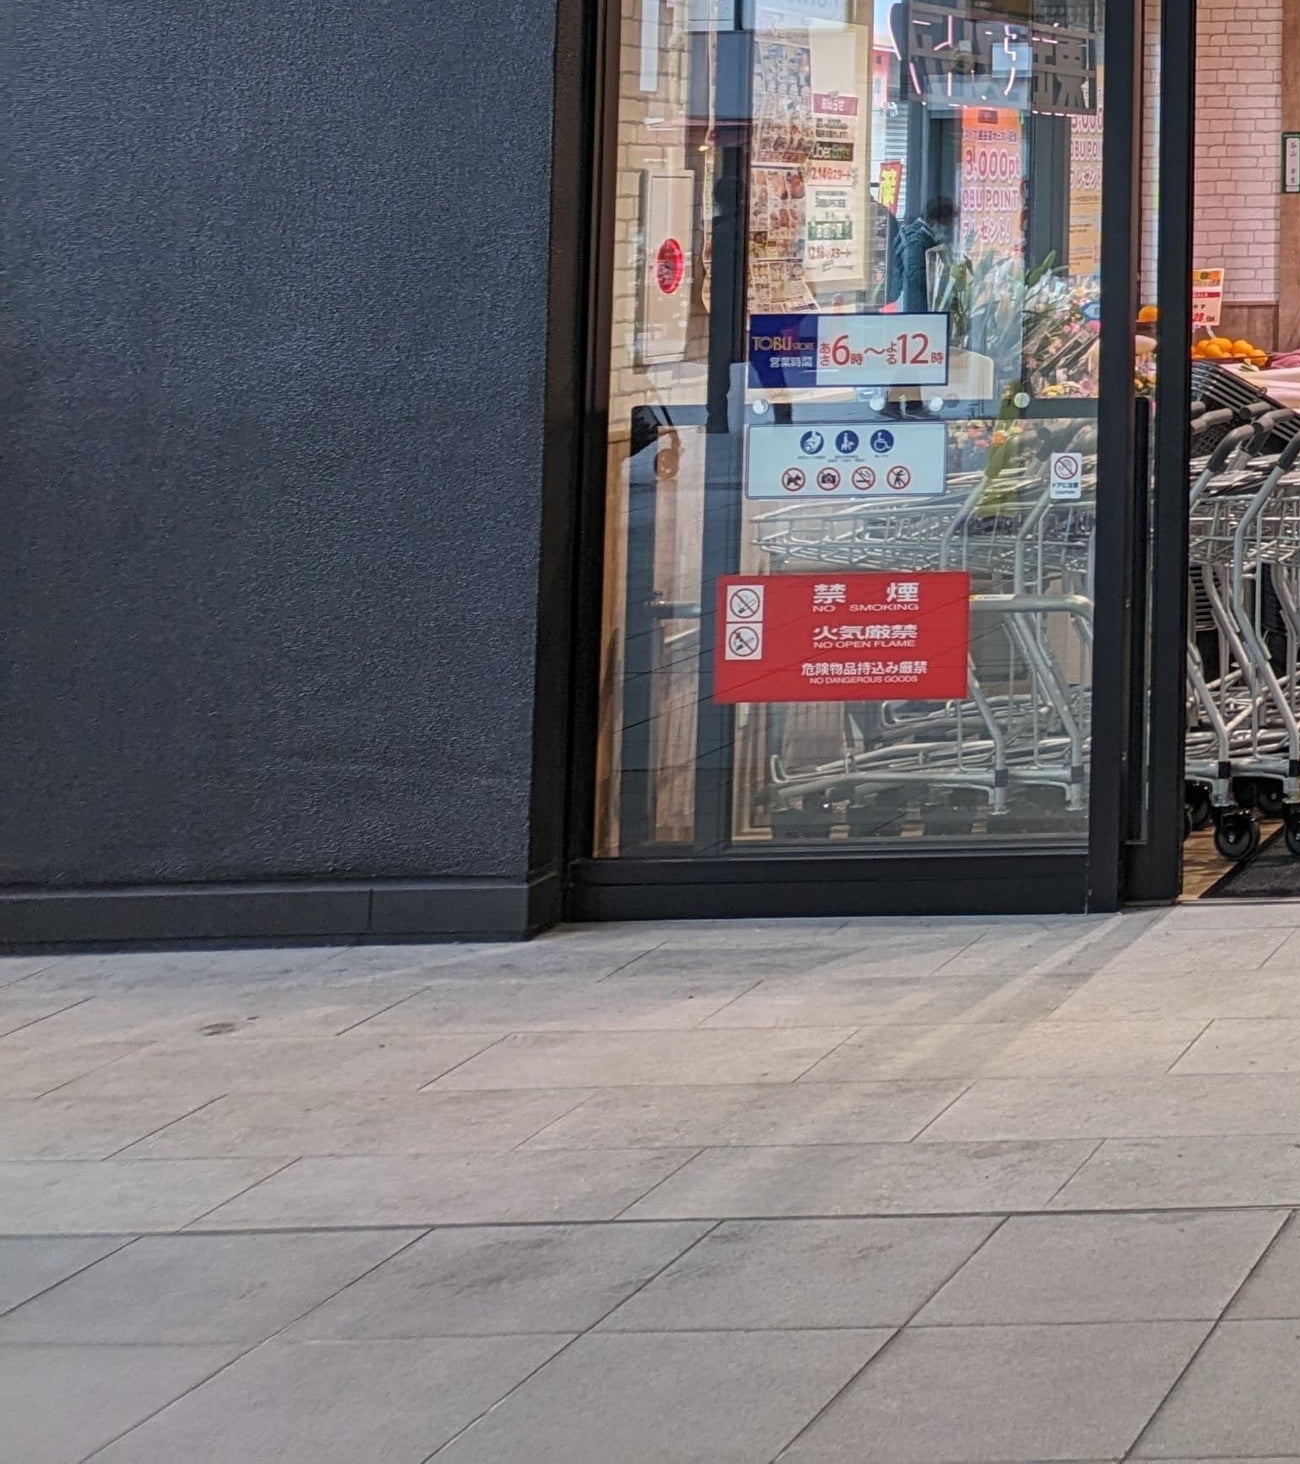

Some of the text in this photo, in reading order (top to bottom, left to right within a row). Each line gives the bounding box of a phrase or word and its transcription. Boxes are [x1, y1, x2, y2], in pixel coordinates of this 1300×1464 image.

[962, 189, 1018, 209] OBU POINT
[752, 336, 792, 352] TOBU
[769, 356, 813, 368] 営業時間
[813, 581, 920, 604] 禁煙
[813, 603, 919, 613] NO SMOKING
[813, 624, 918, 641] 火気厳禁
[814, 639, 916, 649] NO OPEN FLAME
[801, 660, 928, 676] 危険物品持込み厳禁
[809, 675, 918, 685] NO DANGEROUS GOODS
